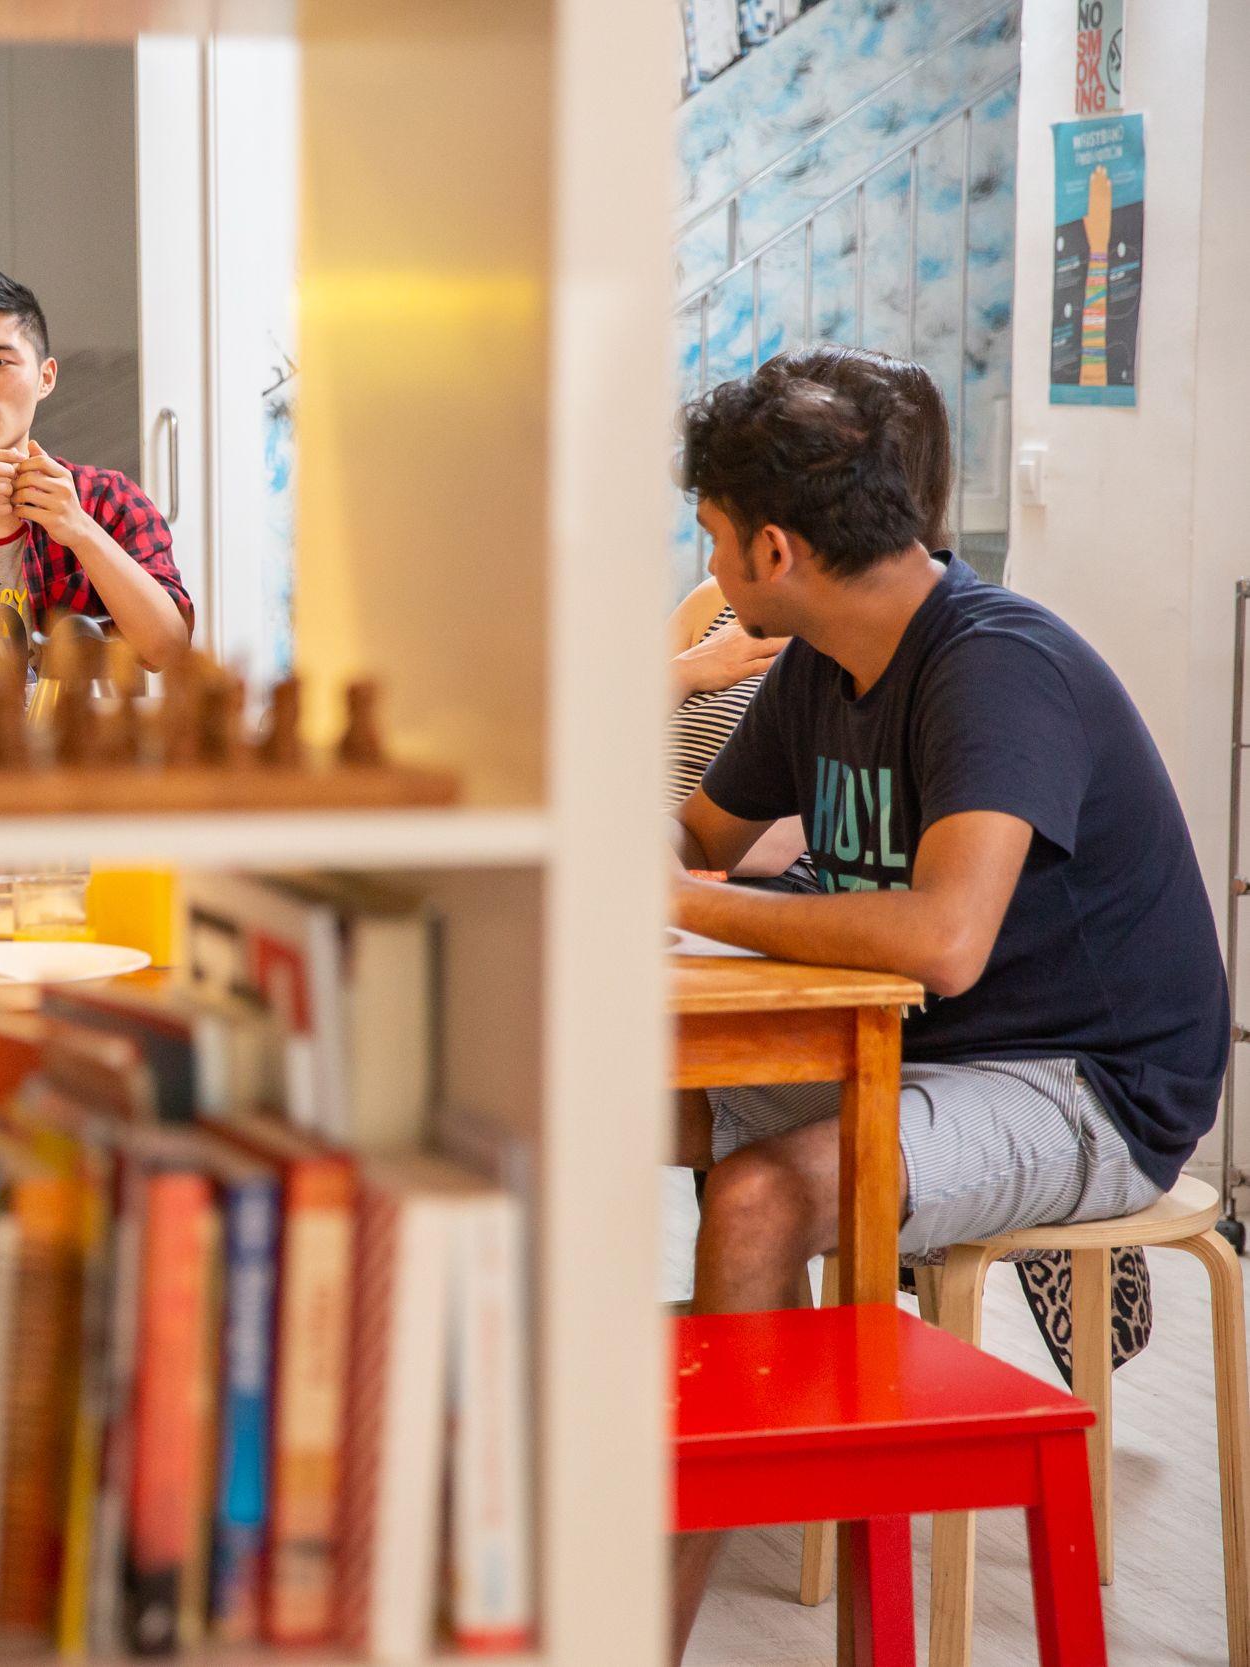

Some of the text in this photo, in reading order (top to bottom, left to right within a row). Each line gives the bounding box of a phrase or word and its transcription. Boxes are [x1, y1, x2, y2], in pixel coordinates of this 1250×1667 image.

[1078, 0, 1102, 31] NO
[1077, 28, 1102, 62] SM
[1077, 58, 1102, 87] OK
[1075, 83, 1105, 114] ING
